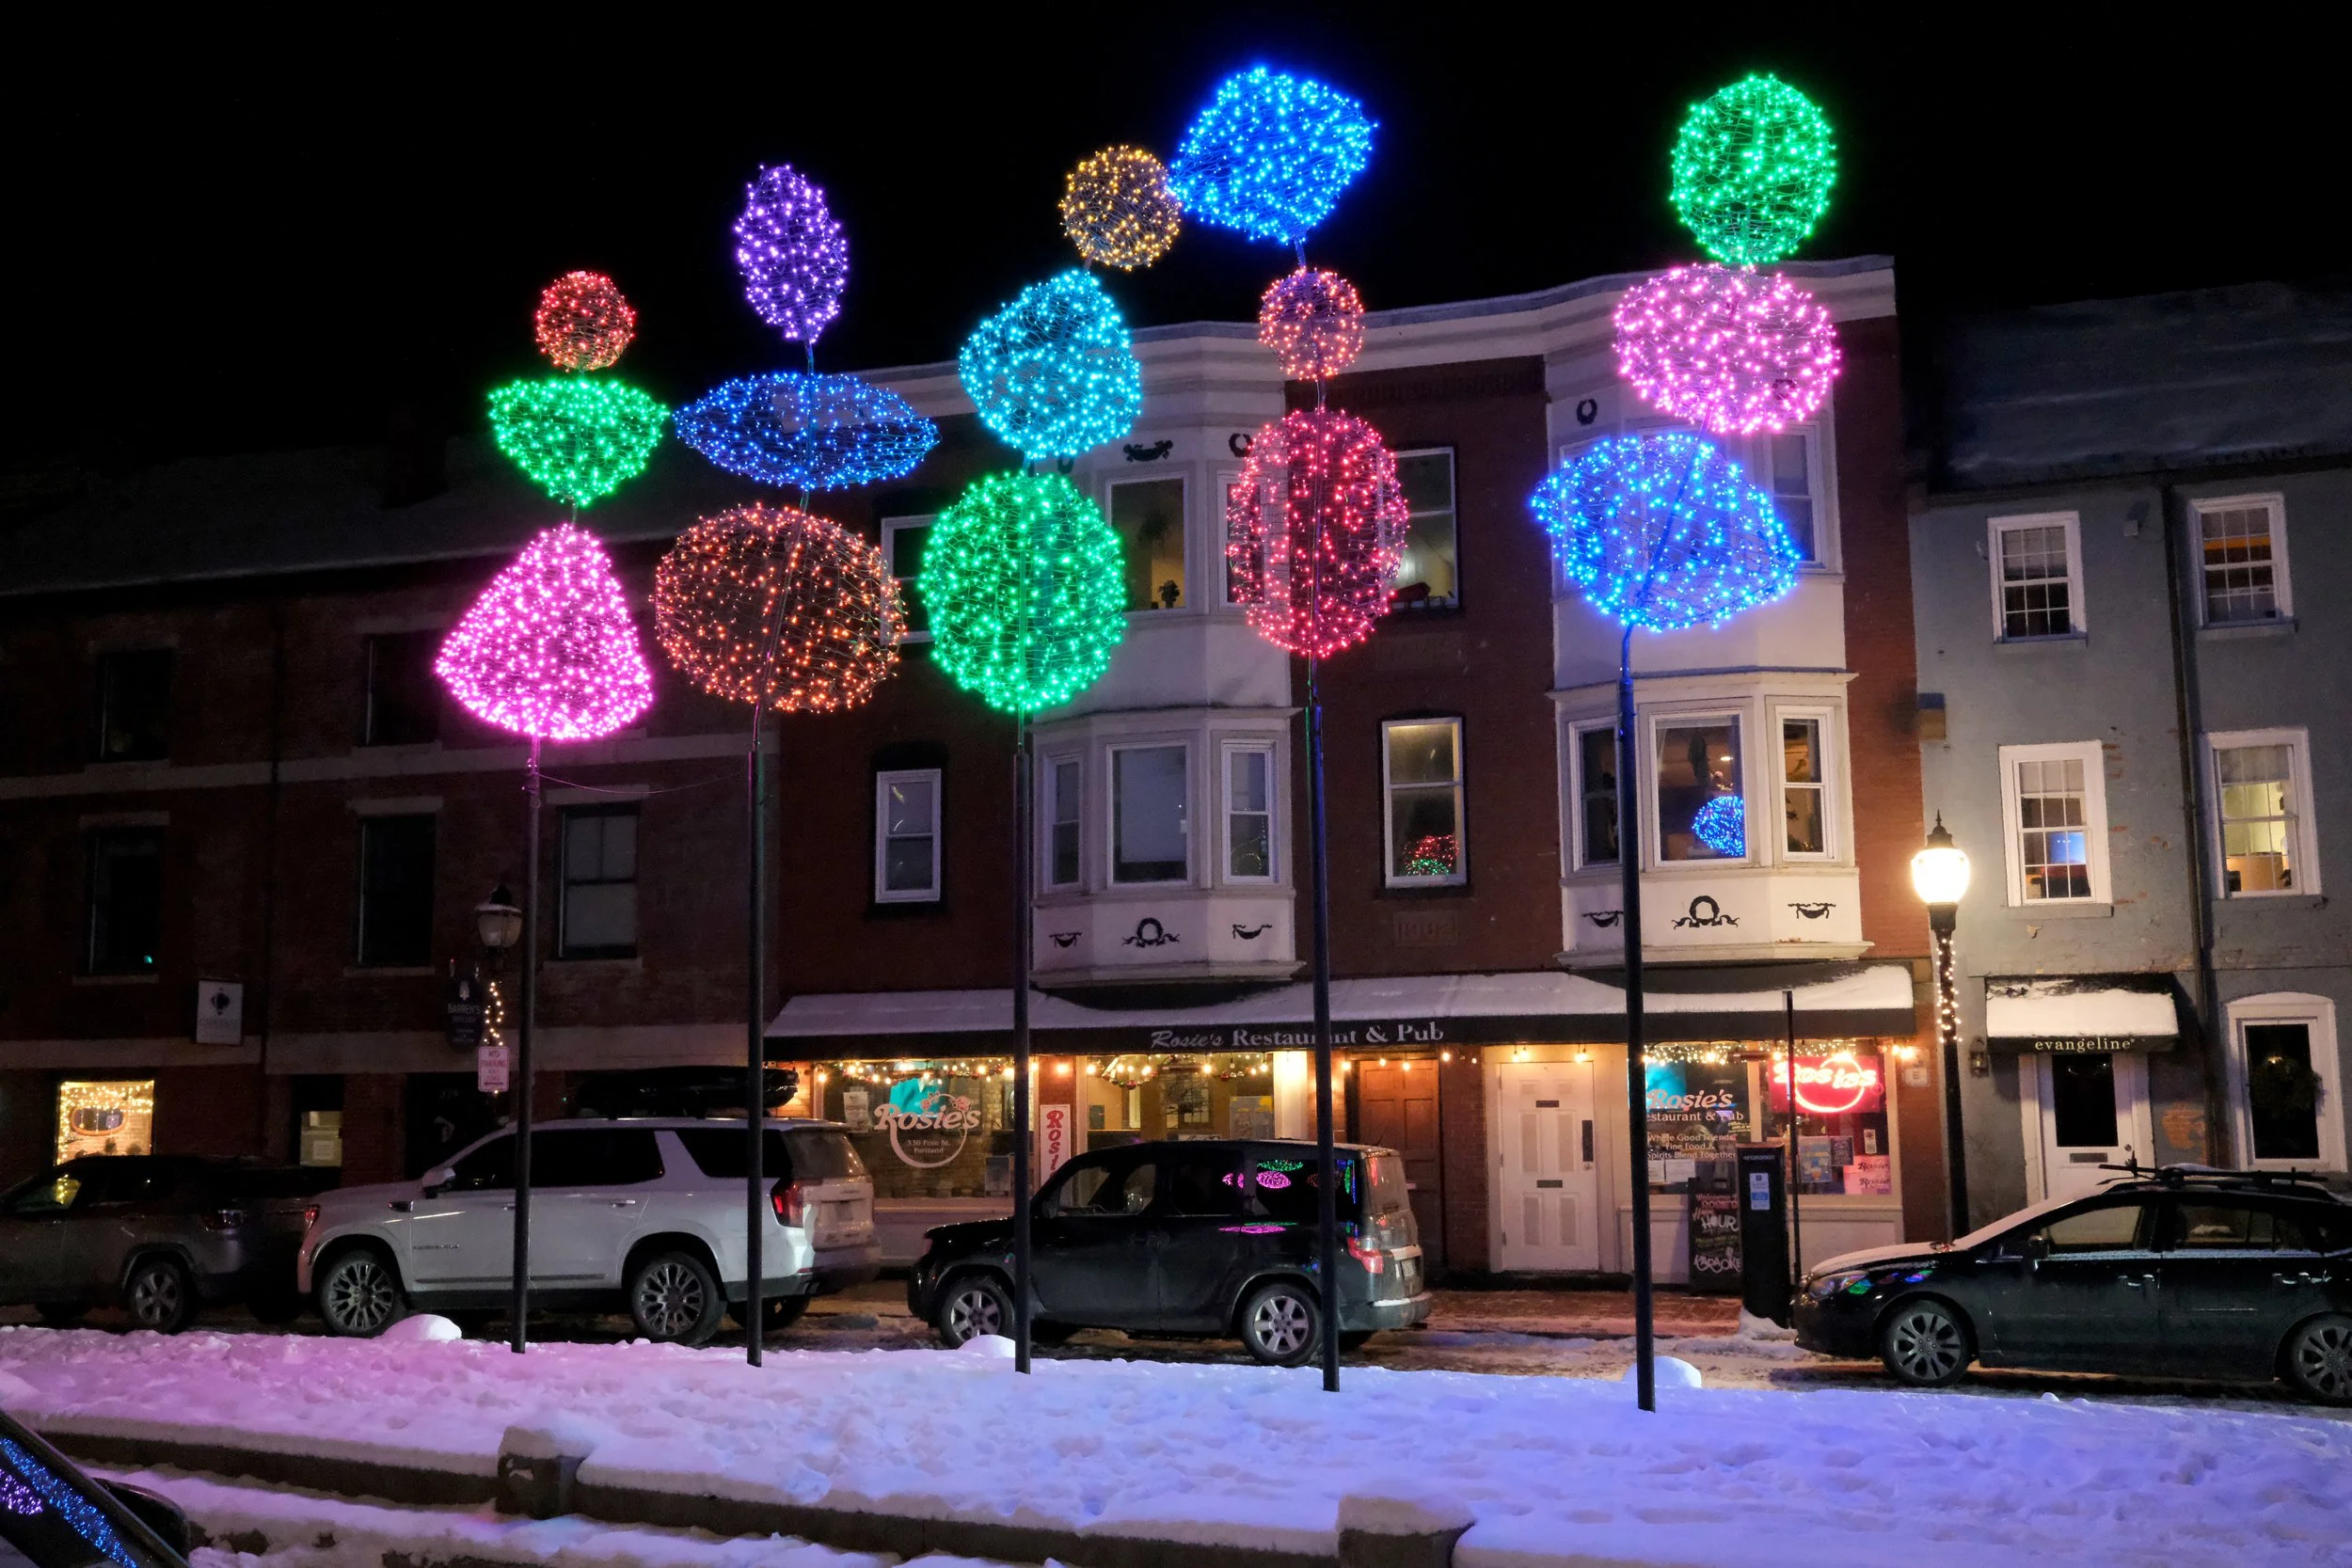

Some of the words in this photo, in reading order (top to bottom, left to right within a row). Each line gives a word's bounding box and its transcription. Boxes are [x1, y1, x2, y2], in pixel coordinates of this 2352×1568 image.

[1151, 1030, 1224, 1049] Rosie's
[1232, 1029, 1357, 1047] Restaurnt
[1365, 1025, 1390, 1043] &
[1397, 1022, 1444, 1042] Pub
[2035, 1037, 2131, 1053] evangeline
[1646, 1089, 1734, 1109] Rosie's
[1645, 1112, 1702, 1122] estaurant
[1705, 1112, 1716, 1121] &
[1677, 1133, 1701, 1142] Good
[1647, 1151, 1672, 1161] Spirits
